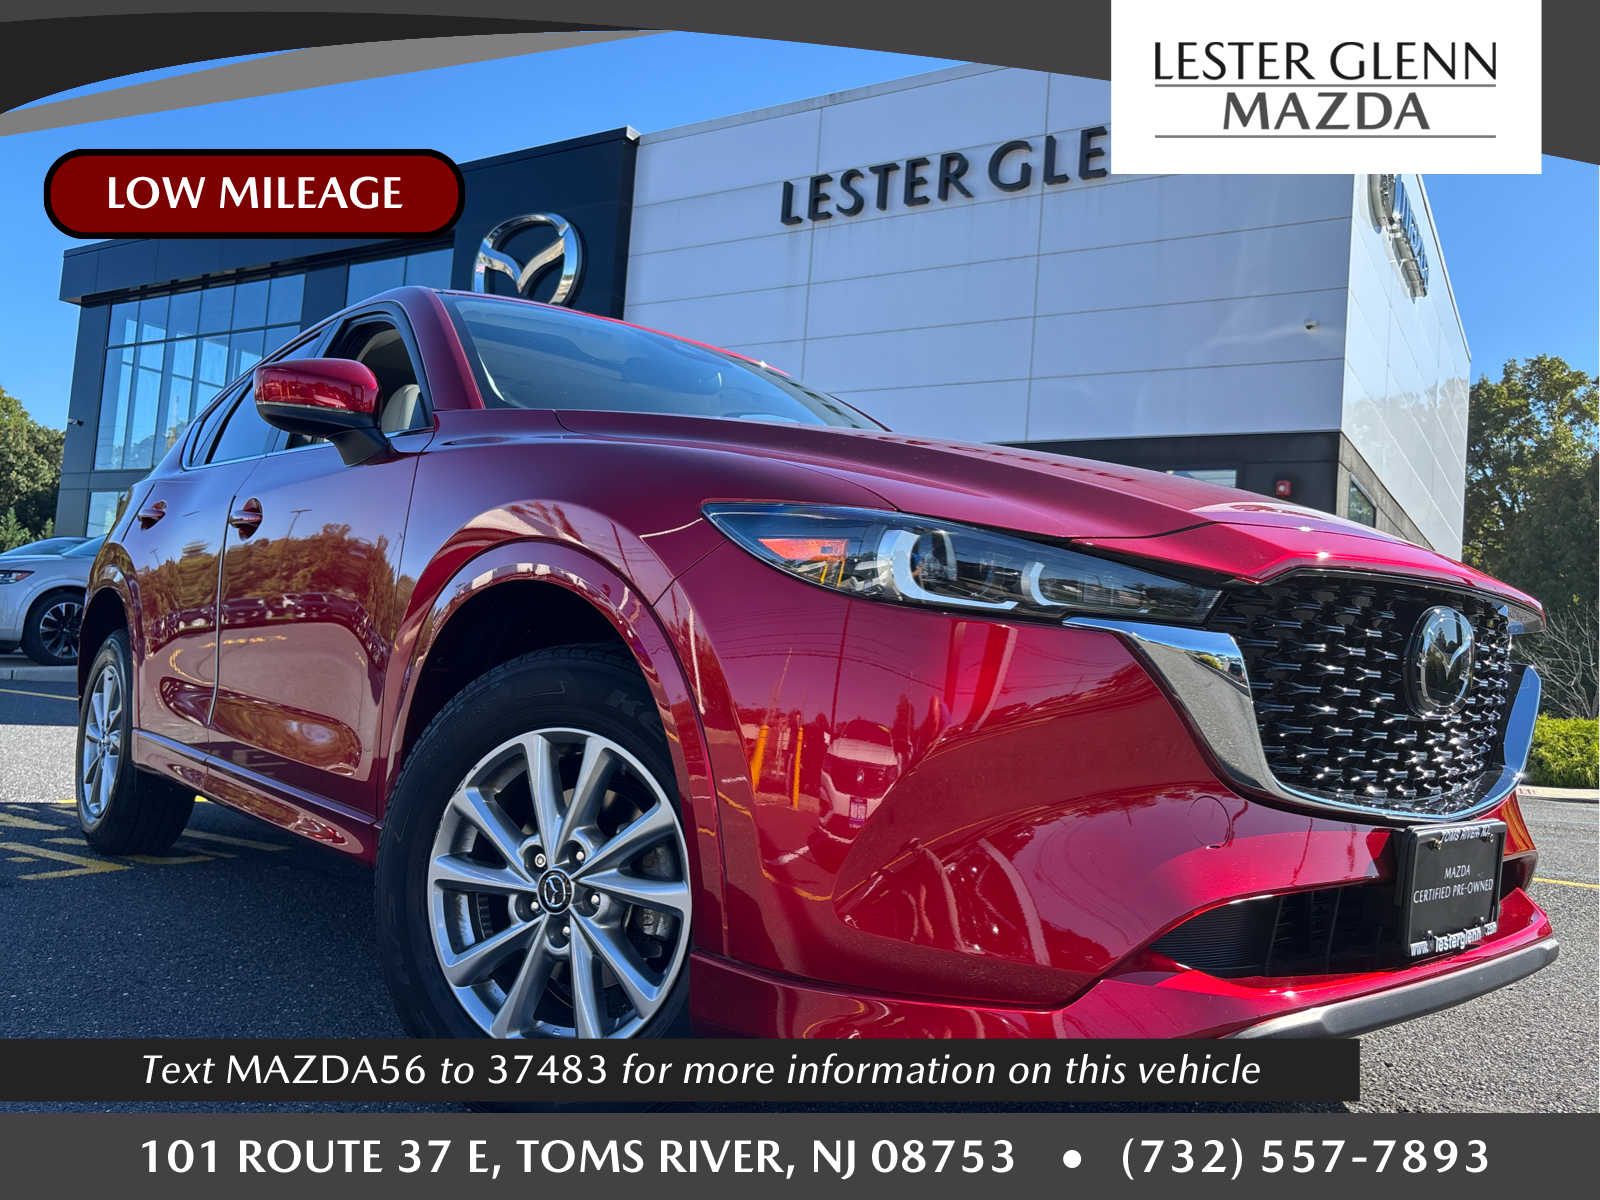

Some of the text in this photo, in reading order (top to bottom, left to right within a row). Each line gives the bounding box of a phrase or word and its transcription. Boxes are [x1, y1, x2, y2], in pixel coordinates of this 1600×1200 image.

[780, 151, 974, 226] LESTER
[1444, 864, 1471, 879] MAZDA
[1413, 878, 1494, 904] CERTIFIED PRE-OWNED
